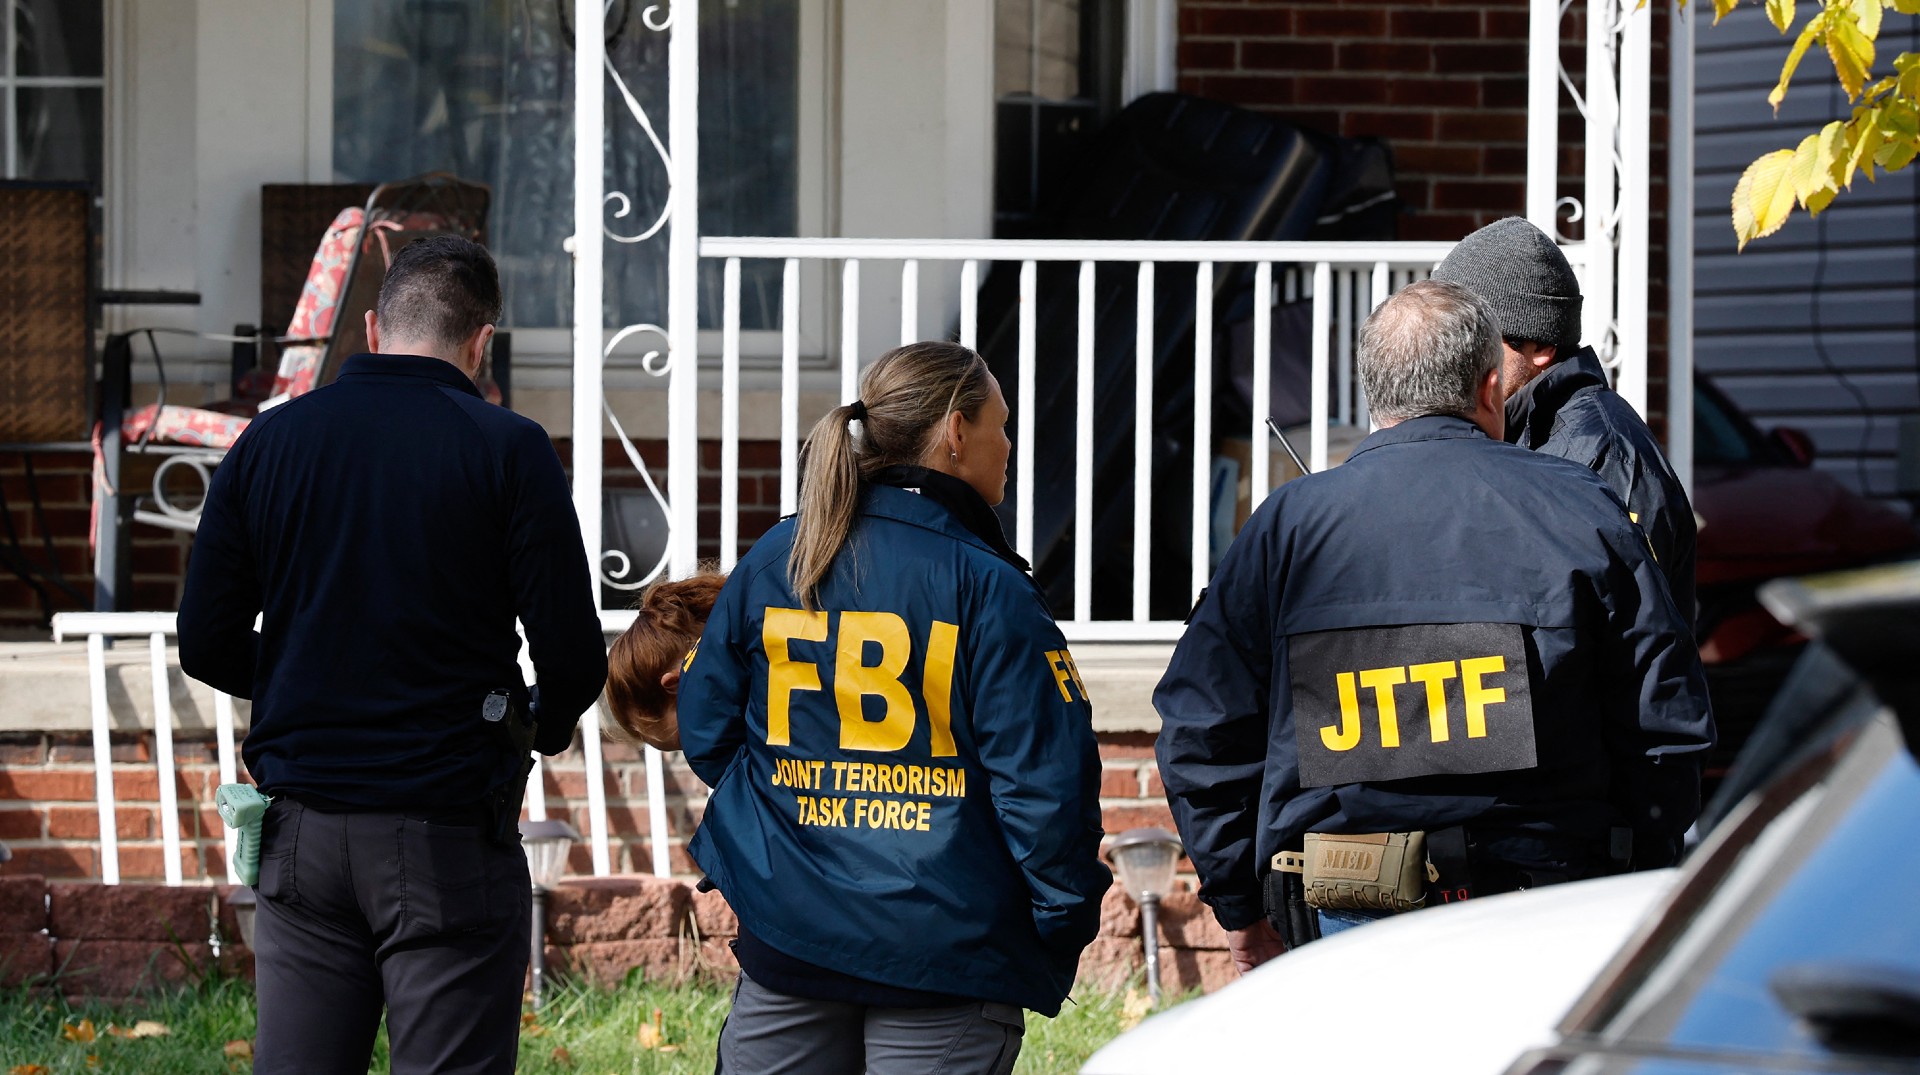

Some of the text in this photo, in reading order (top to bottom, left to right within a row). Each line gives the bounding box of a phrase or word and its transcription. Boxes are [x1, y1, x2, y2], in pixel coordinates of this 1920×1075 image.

[762, 604, 960, 759] FBI
[1319, 655, 1507, 752] JTTF
[771, 758, 966, 798] JOINT TERRORISM
[797, 795, 932, 832] TASK FORCE
[1323, 849, 1374, 871] MED
